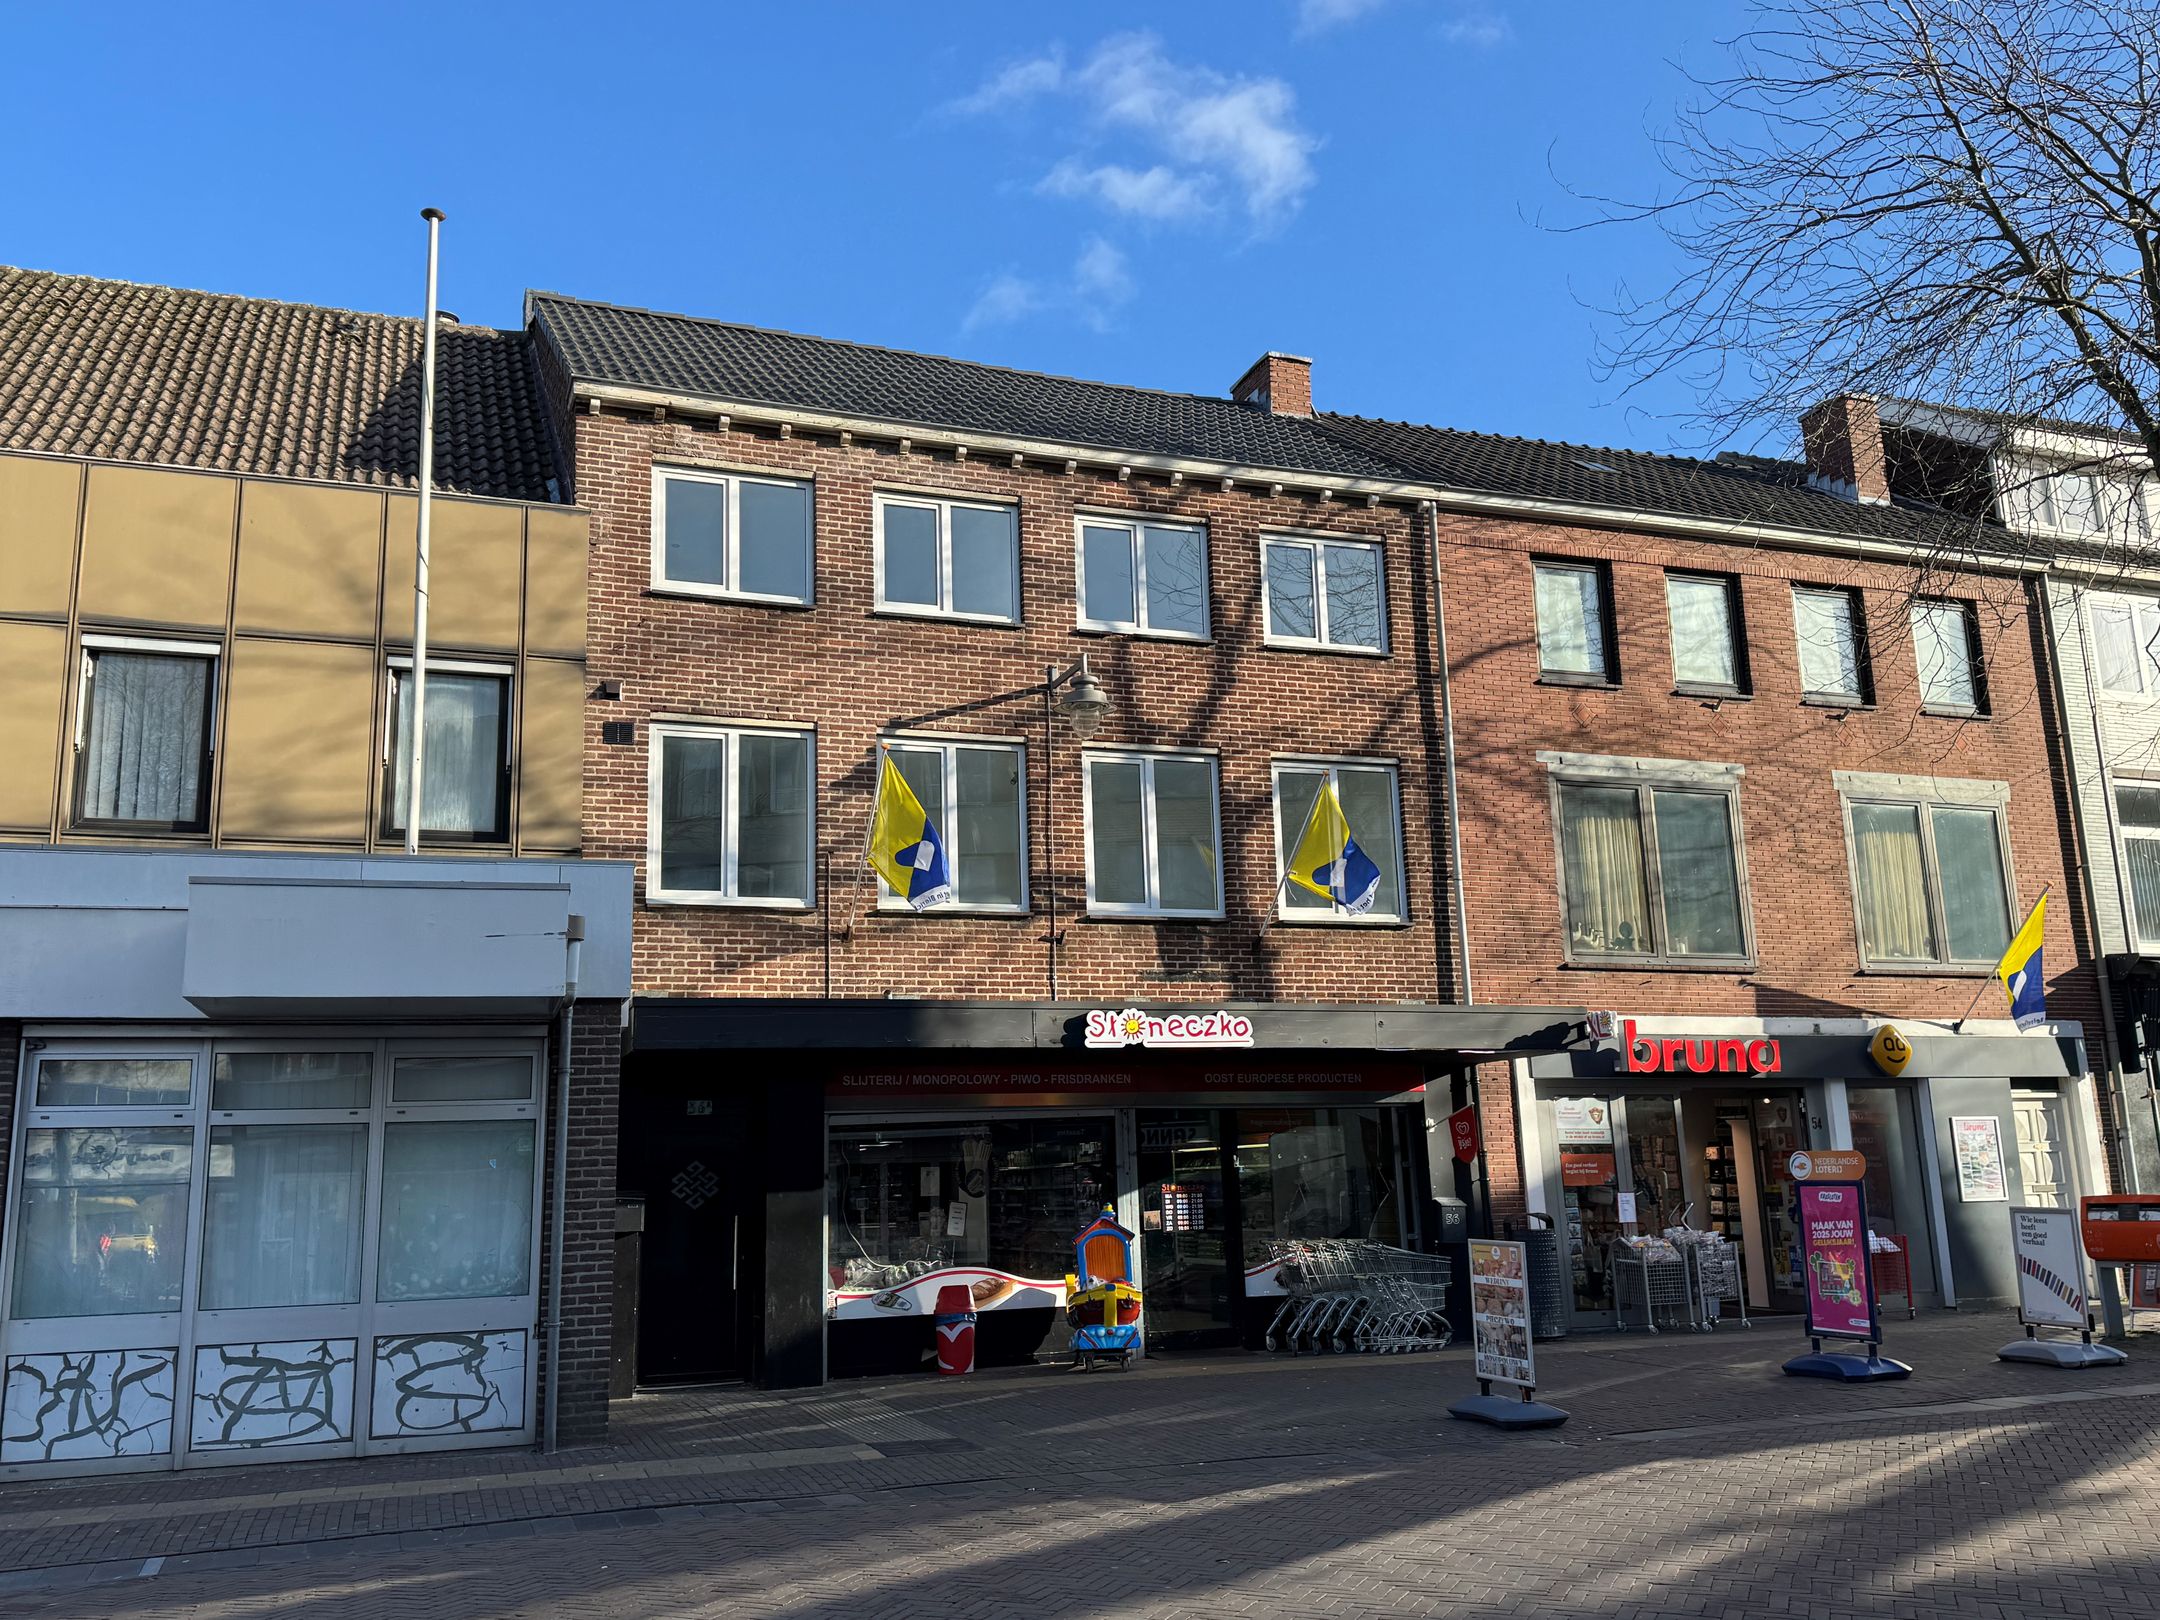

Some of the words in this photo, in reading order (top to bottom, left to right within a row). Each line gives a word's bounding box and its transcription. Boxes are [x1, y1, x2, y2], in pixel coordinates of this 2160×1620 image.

[1623, 1019, 1781, 1073] bruna
[842, 1075, 903, 1087] SLIJTERIJ
[912, 1074, 1000, 1086] MONOPOLOWY
[1011, 1074, 1041, 1085] PIWO
[1051, 1073, 1131, 1085] FRISDRANKEN
[1204, 1073, 1234, 1084] OOST
[1237, 1073, 1295, 1084] EUROPESE
[1297, 1073, 1362, 1084] PRODUCTEN
[1811, 1117, 1822, 1130] 54
[1815, 1157, 1859, 1165] NEDERLANDSE
[1815, 1165, 1842, 1174] LOTERIJ
[1445, 1213, 1460, 1225] 56
[2020, 1215, 2032, 1223] Wie
[2033, 1216, 2047, 1224] leest
[1811, 1221, 1835, 1230] MAAK
[1836, 1220, 1853, 1229] VAN
[2021, 1223, 2036, 1231] heeft
[1812, 1230, 1830, 1239] 2025
[1831, 1229, 1854, 1238] JOUW
[2022, 1238, 2045, 1246] verhaal
